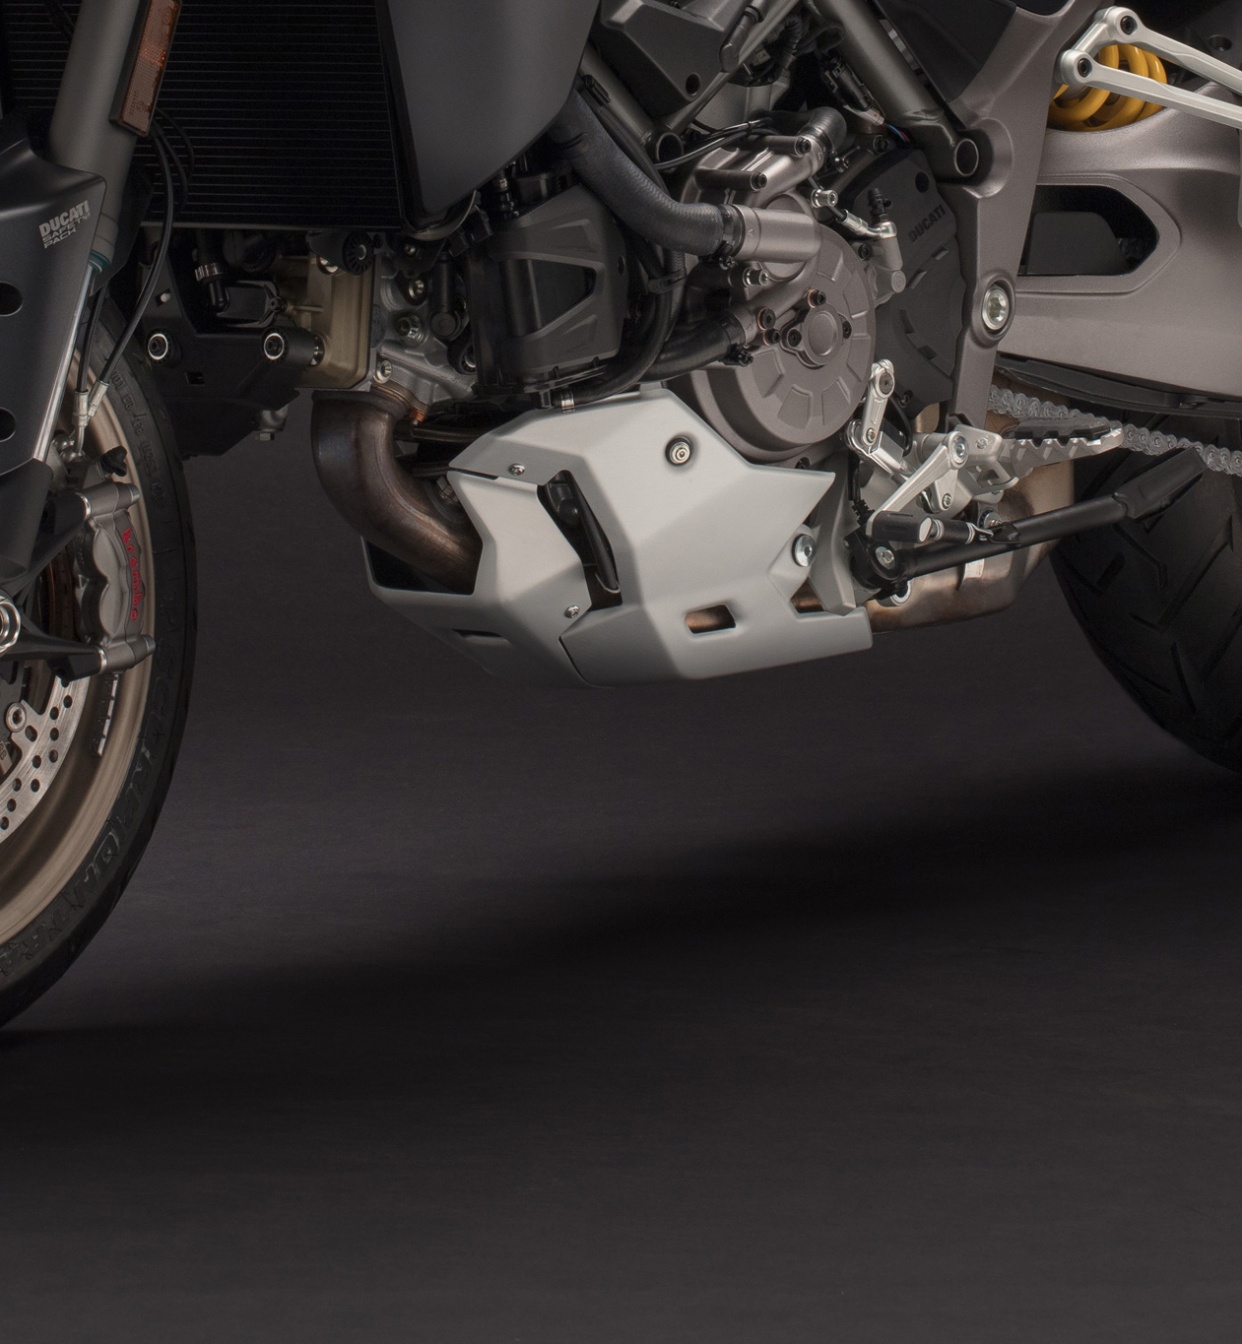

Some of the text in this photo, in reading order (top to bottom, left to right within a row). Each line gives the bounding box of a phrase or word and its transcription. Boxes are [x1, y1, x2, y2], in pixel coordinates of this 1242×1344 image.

[39, 200, 90, 237] DUCATI
[908, 204, 946, 243] DUCATI
[43, 227, 77, 249] PACK
[122, 527, 143, 622] brembo
